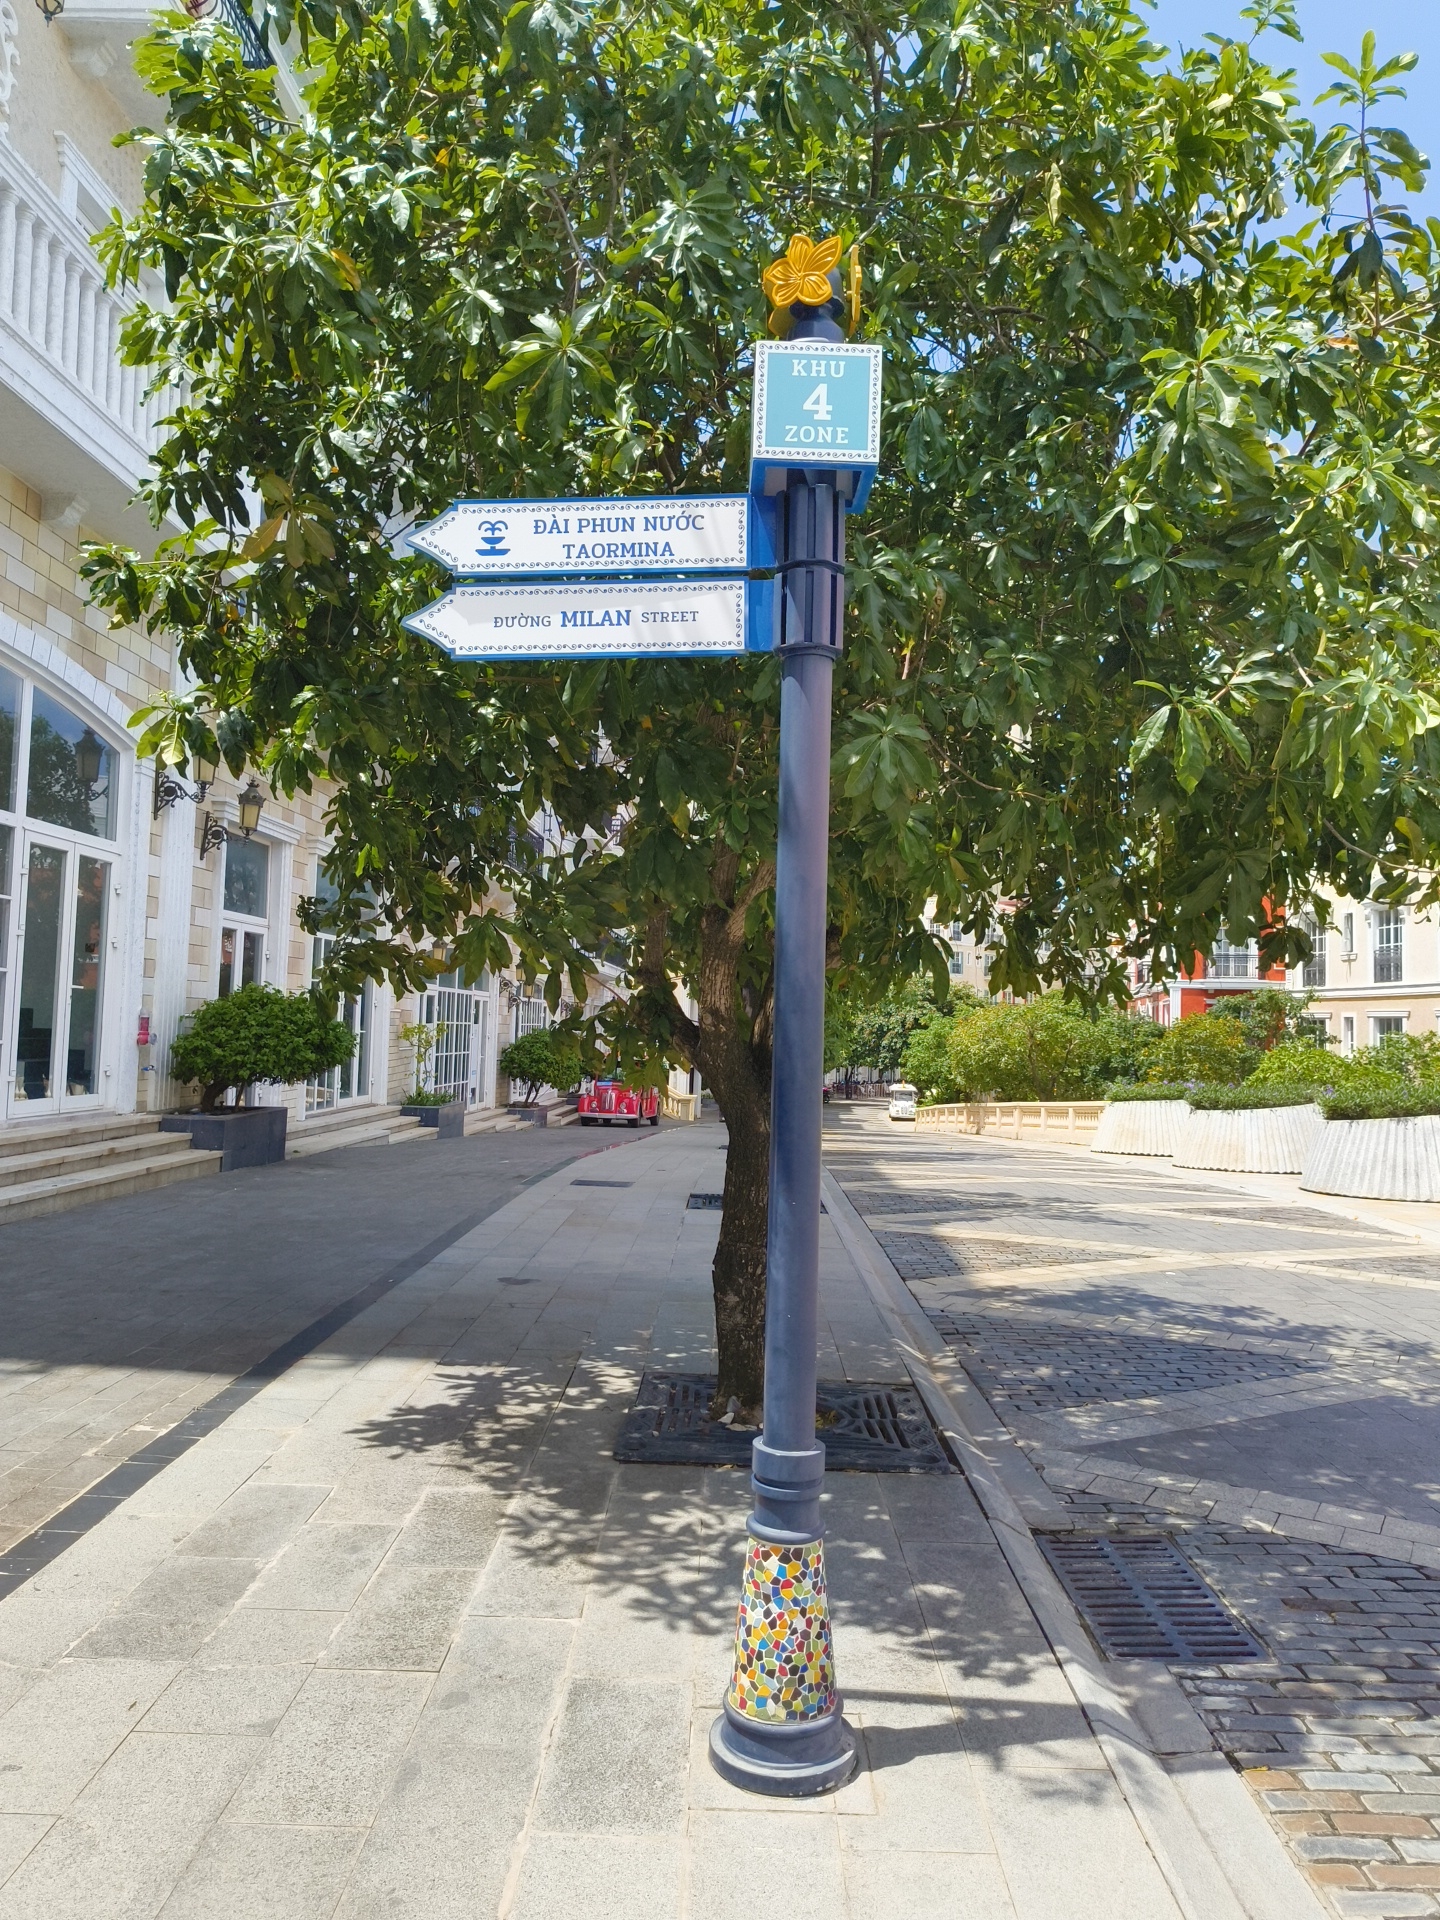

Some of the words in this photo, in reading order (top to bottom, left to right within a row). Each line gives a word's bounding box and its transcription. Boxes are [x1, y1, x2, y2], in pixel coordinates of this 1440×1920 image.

[792, 359, 846, 378] KHU
[802, 383, 833, 421] 4
[784, 425, 849, 444] ZONE
[533, 515, 570, 534] ĐÀI
[577, 516, 636, 534] PHUN
[643, 510, 705, 532] NƯỚC
[562, 541, 675, 559] TAORMINA
[493, 612, 552, 629] ĐƯỜNG
[560, 609, 632, 628] MILAN
[641, 610, 699, 624] STREET
